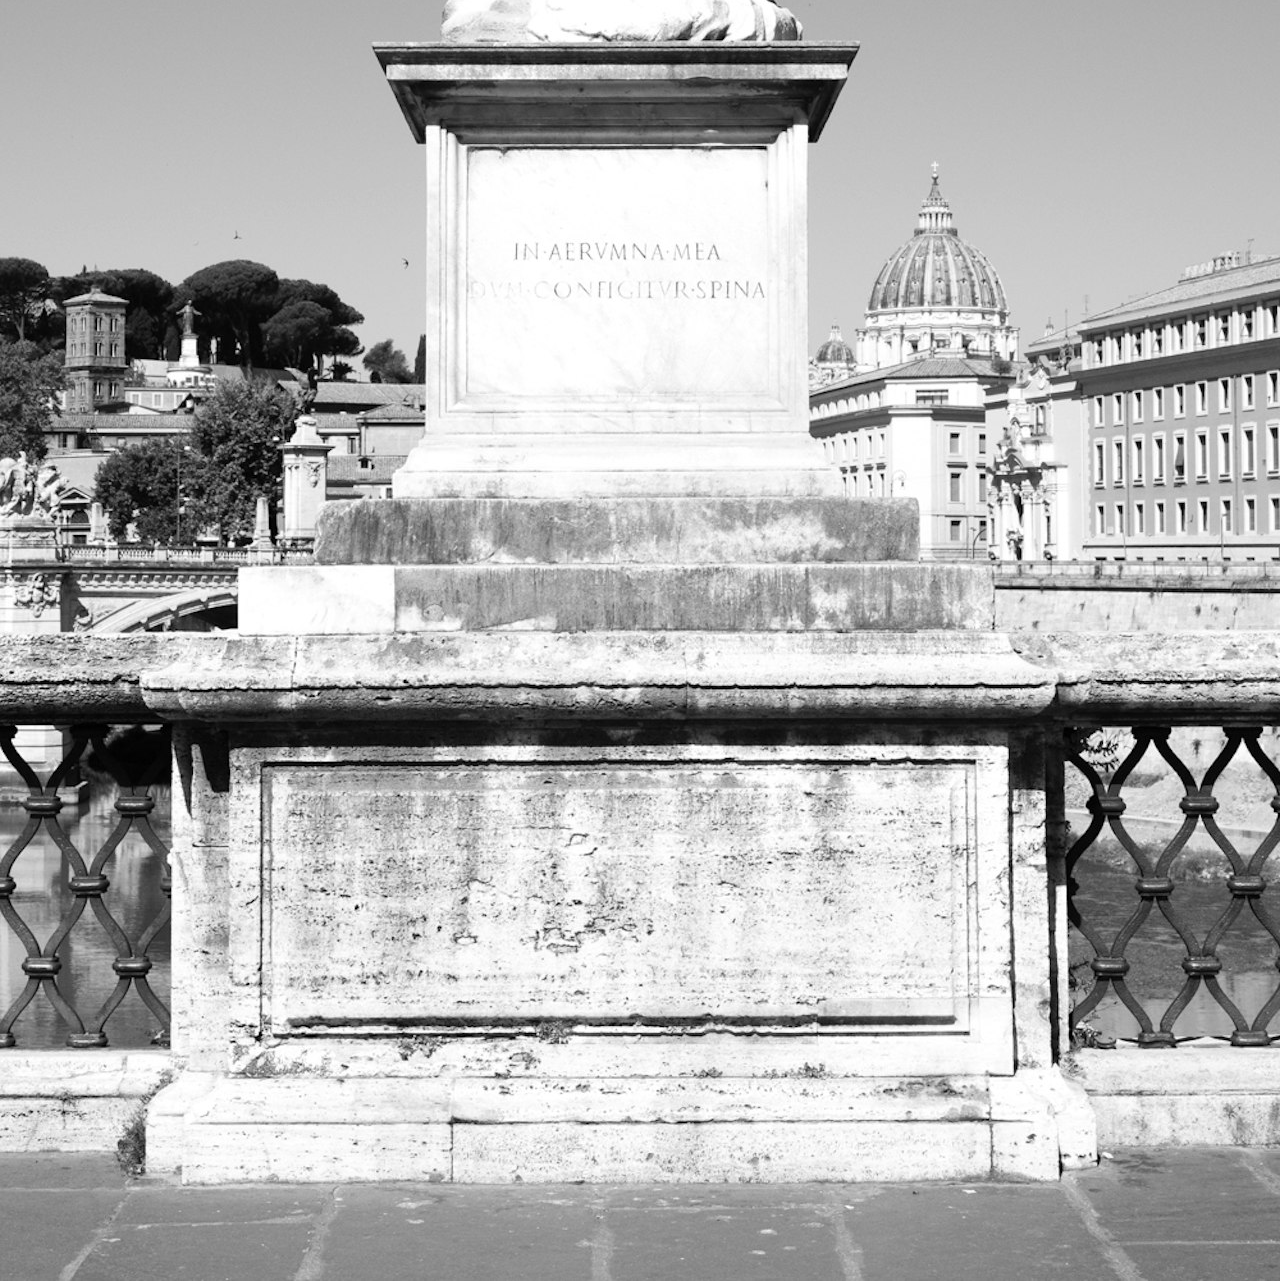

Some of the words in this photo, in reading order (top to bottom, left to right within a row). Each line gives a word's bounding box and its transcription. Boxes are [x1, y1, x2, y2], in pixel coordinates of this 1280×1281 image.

[513, 242, 539, 261] IN
[548, 242, 664, 261] AERVMNA
[673, 242, 721, 261] MEA
[534, 280, 689, 299] CONFIGITVR
[696, 280, 765, 299] SPINA
